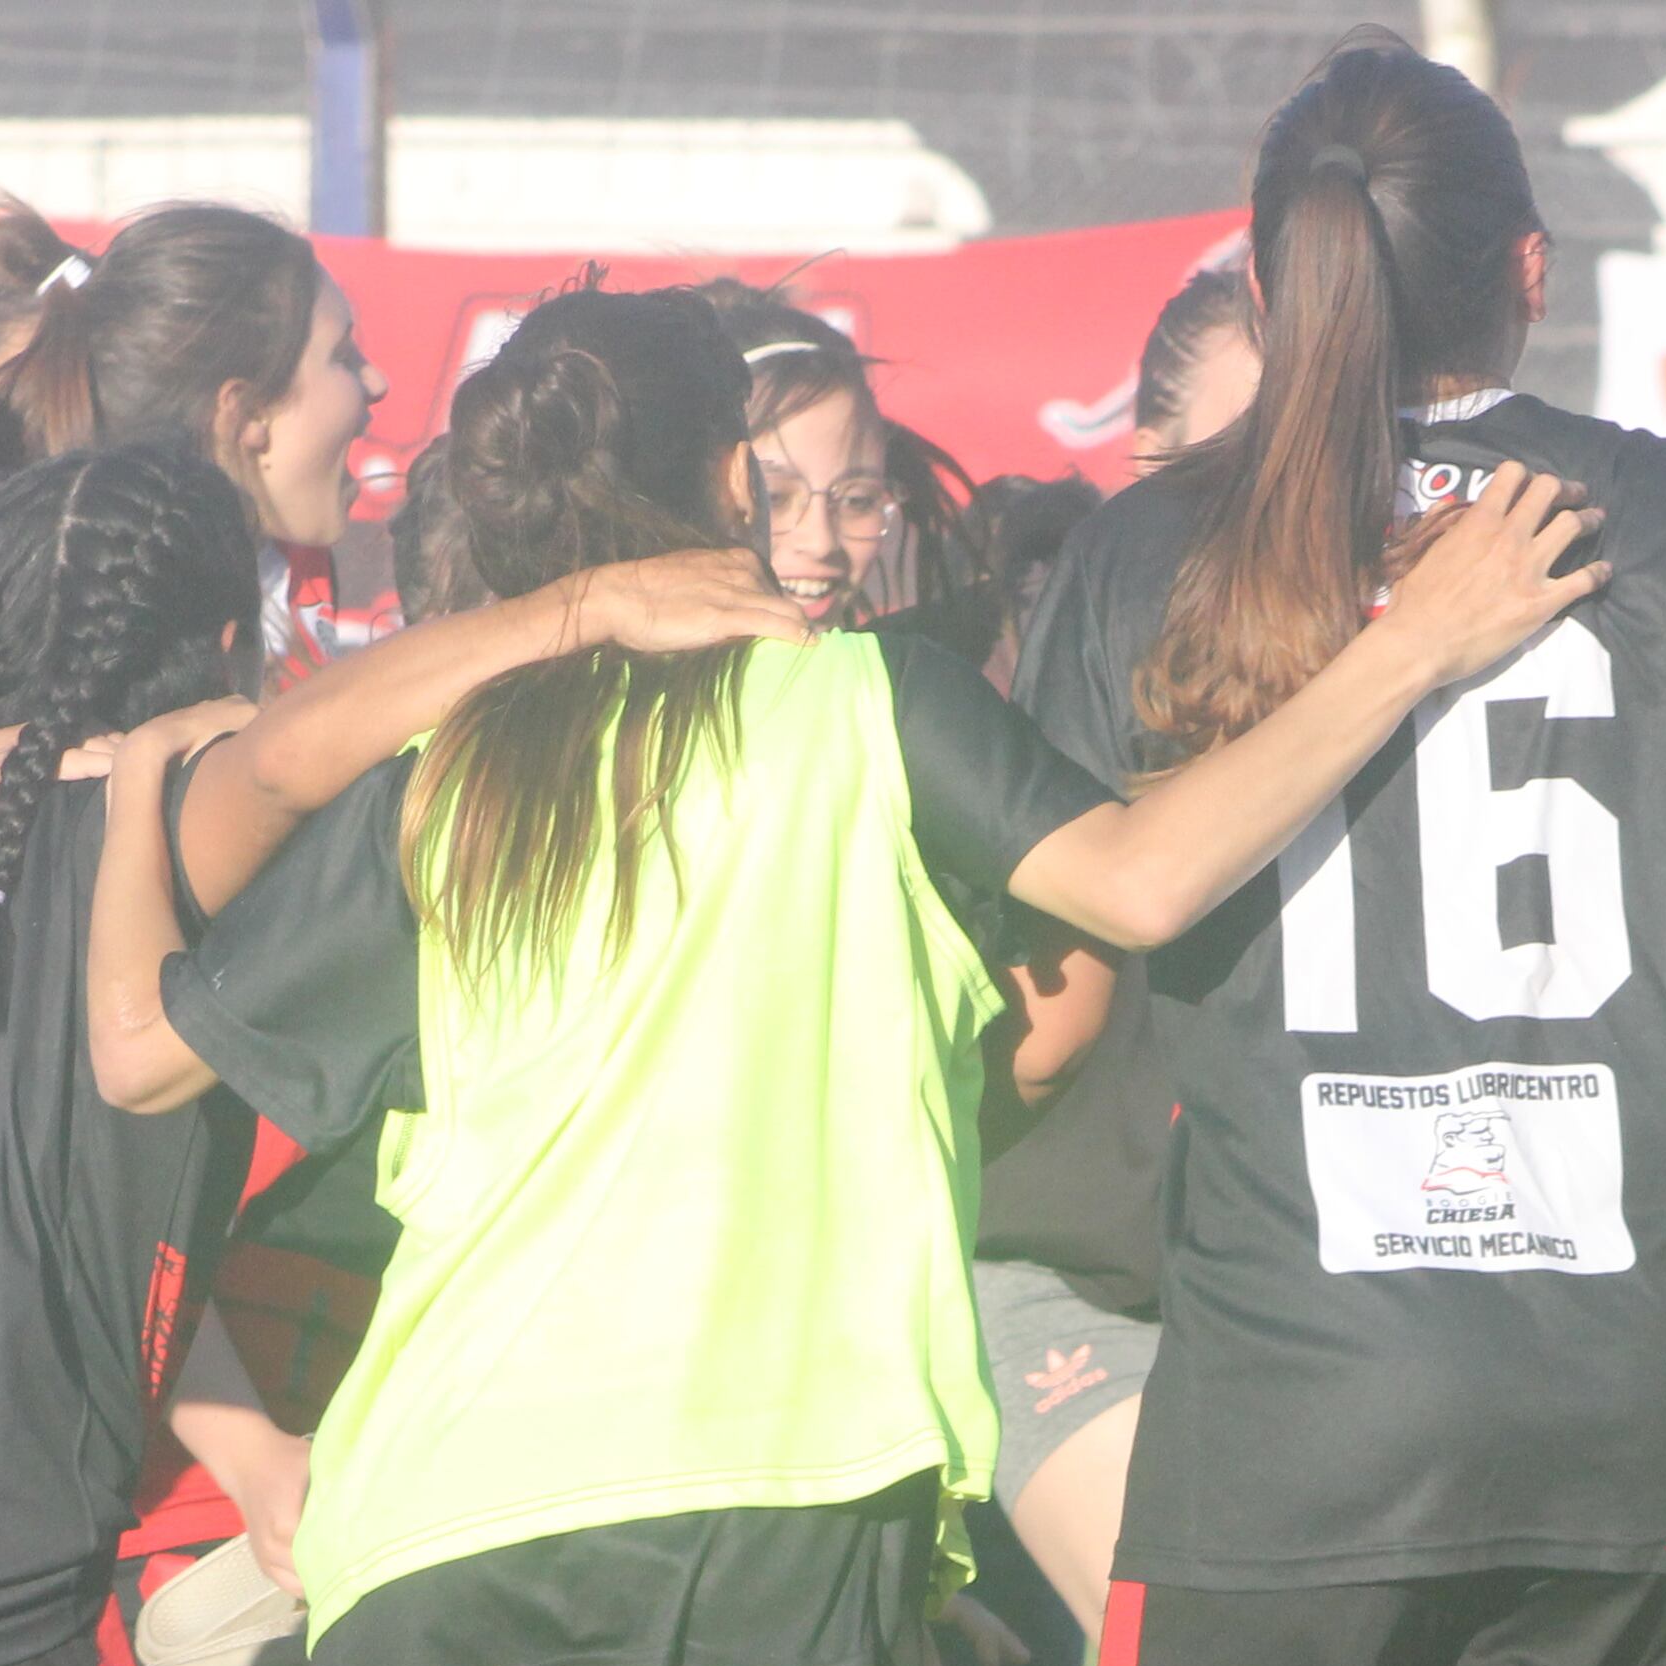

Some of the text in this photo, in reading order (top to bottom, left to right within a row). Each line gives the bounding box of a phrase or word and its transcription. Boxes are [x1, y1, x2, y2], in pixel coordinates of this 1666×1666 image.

[1317, 1073, 1599, 1110] REPUESTOS LUBRICENTRO
[1426, 1203, 1516, 1225] CHIESA
[1374, 1231, 1579, 1262] SERVICIO MECANICO
